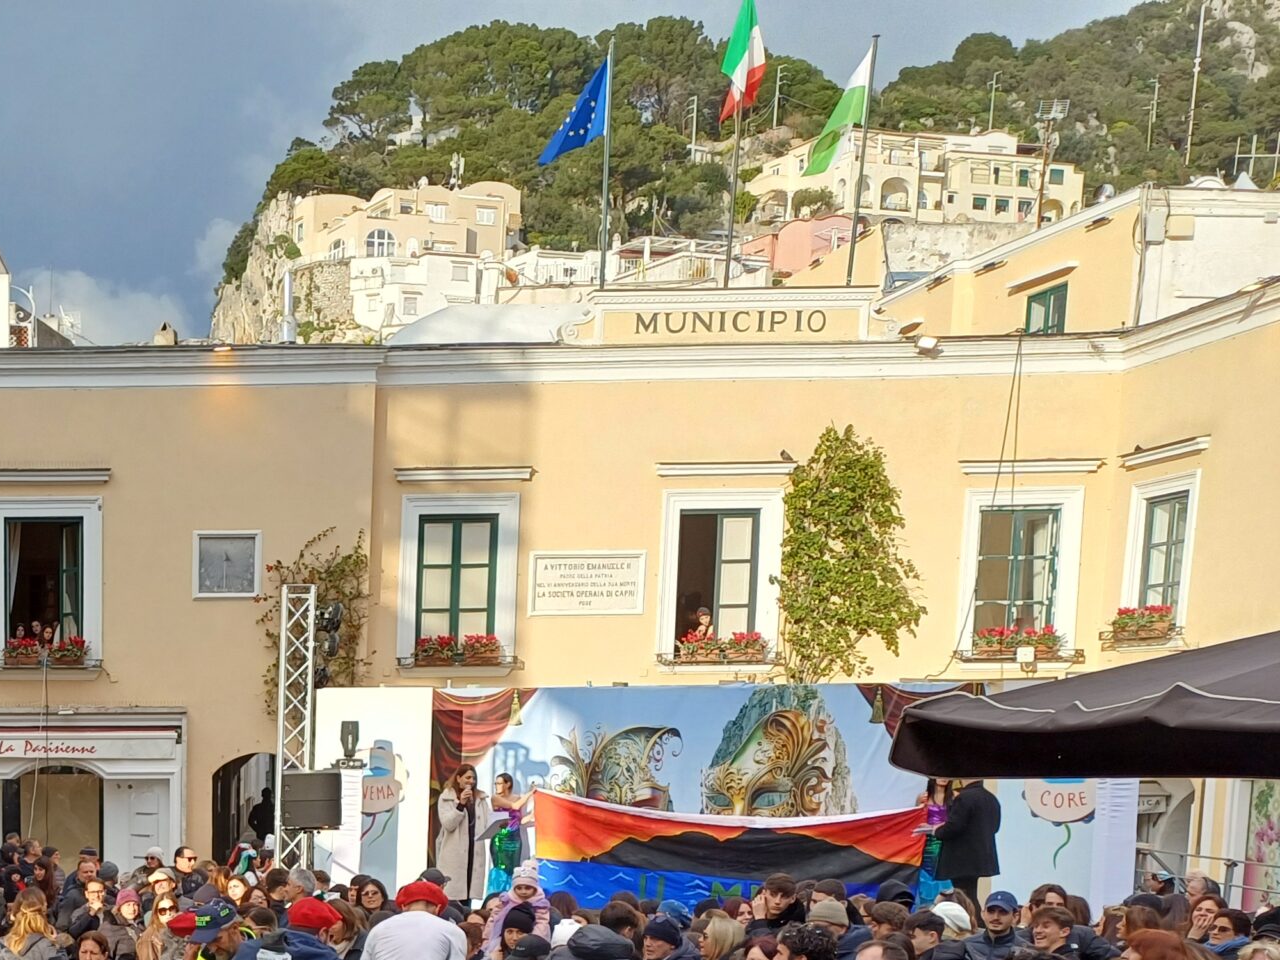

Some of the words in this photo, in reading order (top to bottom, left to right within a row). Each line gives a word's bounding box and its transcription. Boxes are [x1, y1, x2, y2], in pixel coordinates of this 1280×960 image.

[634, 310, 826, 334] MUNICIPIO
[586, 562, 625, 570] EMANUELE
[0, 740, 15, 755] La
[24, 740, 96, 756] Parisienne
[1040, 790, 1087, 808] CORE
